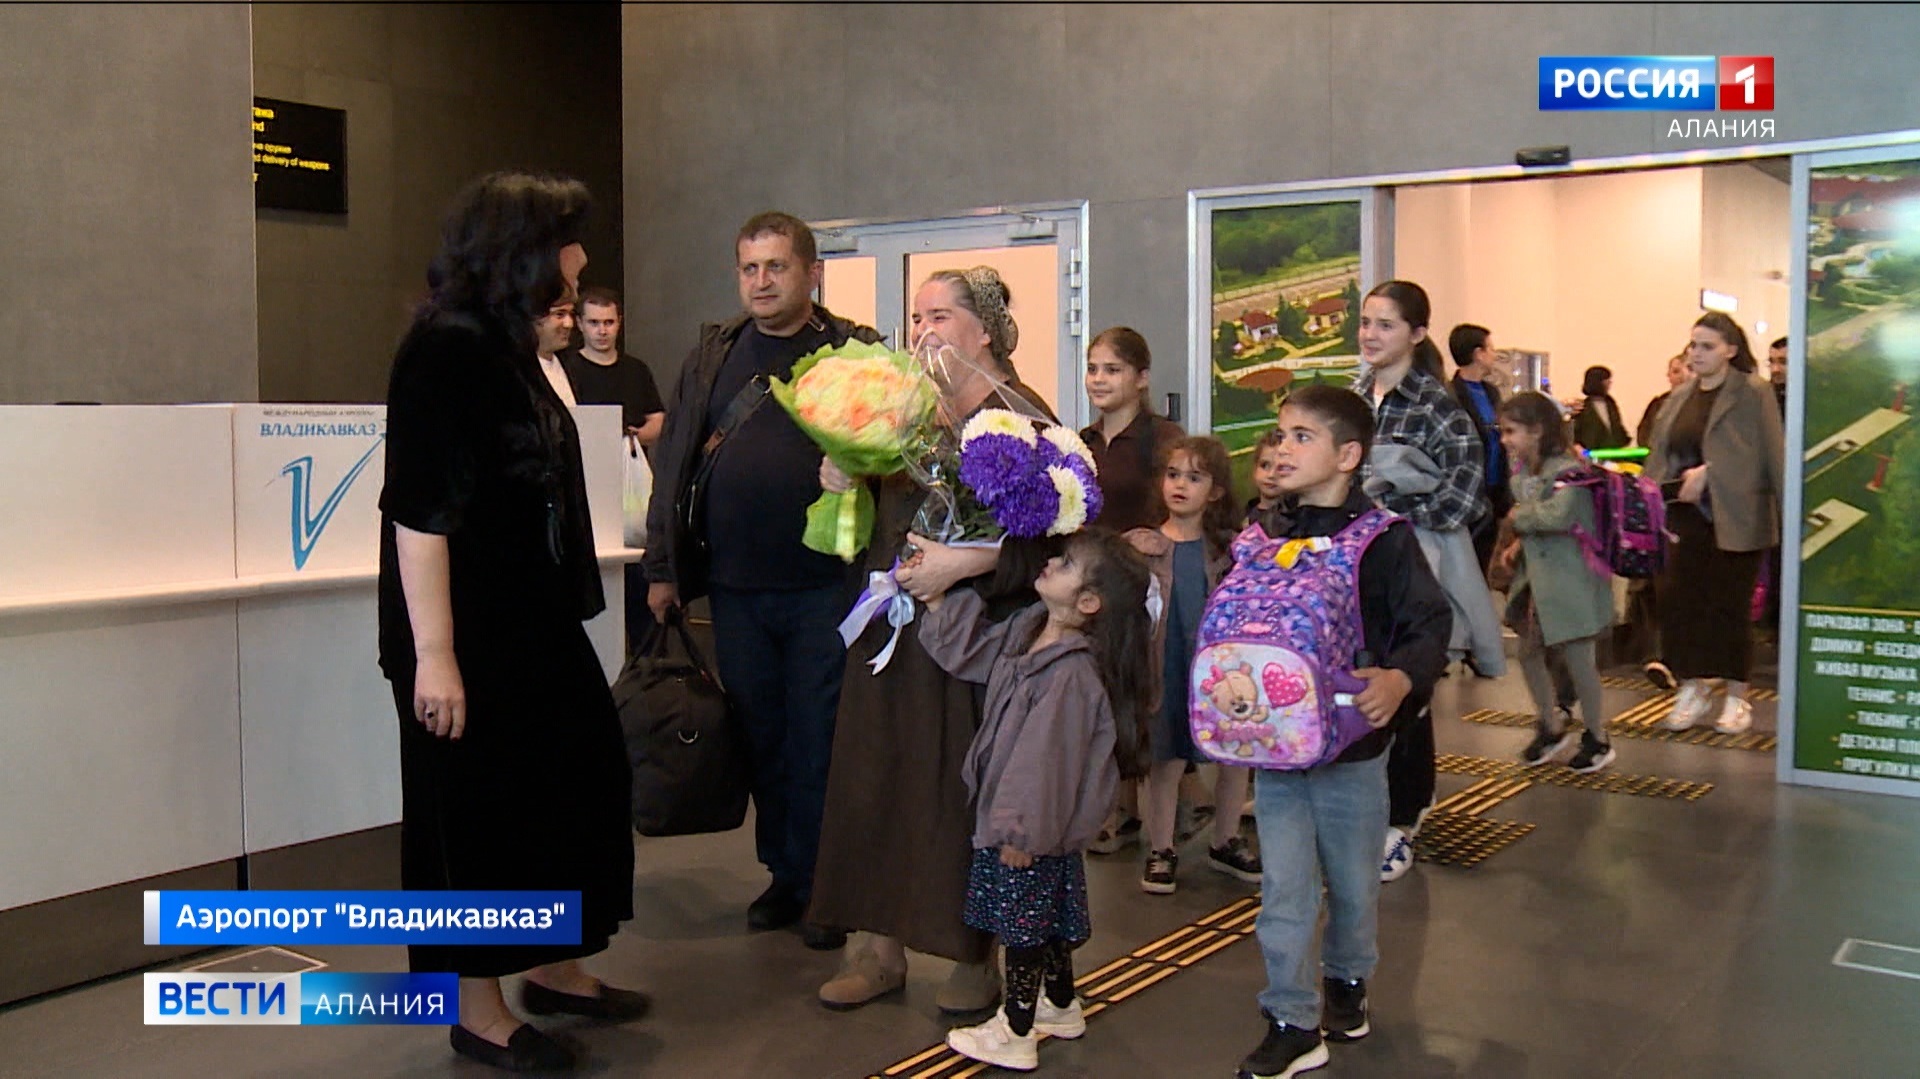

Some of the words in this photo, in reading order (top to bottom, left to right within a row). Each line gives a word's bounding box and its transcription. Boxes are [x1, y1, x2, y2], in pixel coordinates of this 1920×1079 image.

[262, 154, 289, 168] delivery
[299, 160, 330, 171] weapons
[260, 422, 377, 437] ВЛАДИКАВКАЗ
